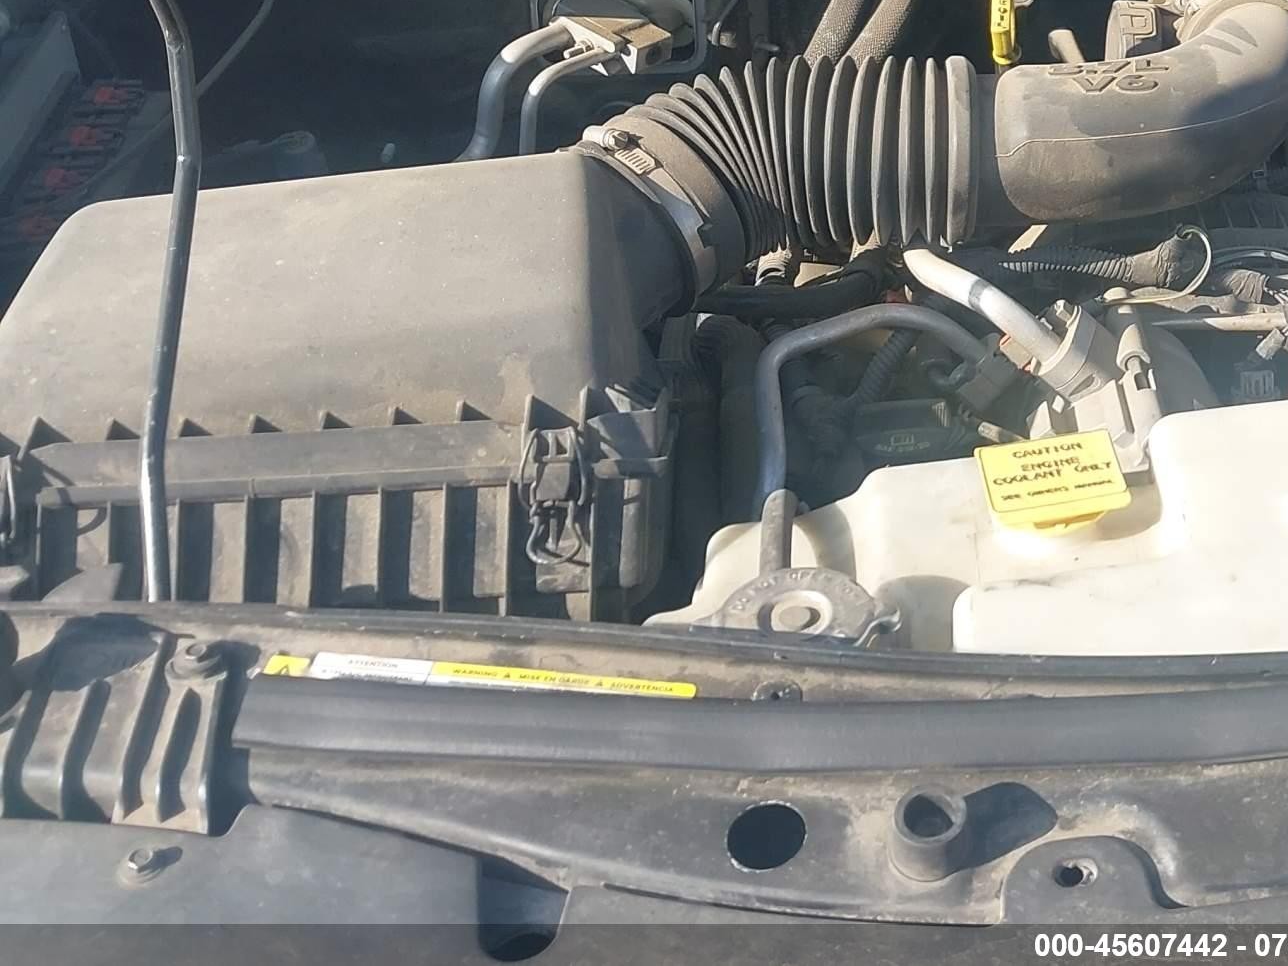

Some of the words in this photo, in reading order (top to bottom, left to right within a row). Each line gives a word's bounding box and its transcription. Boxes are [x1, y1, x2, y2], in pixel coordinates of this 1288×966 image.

[1073, 74, 1160, 94] V6
[1013, 442, 1083, 459] CAUTION
[1021, 457, 1081, 472] ENGINE
[993, 470, 1062, 486] COOLANT
[1074, 461, 1112, 473] ONLY
[453, 668, 498, 678] WARNING
